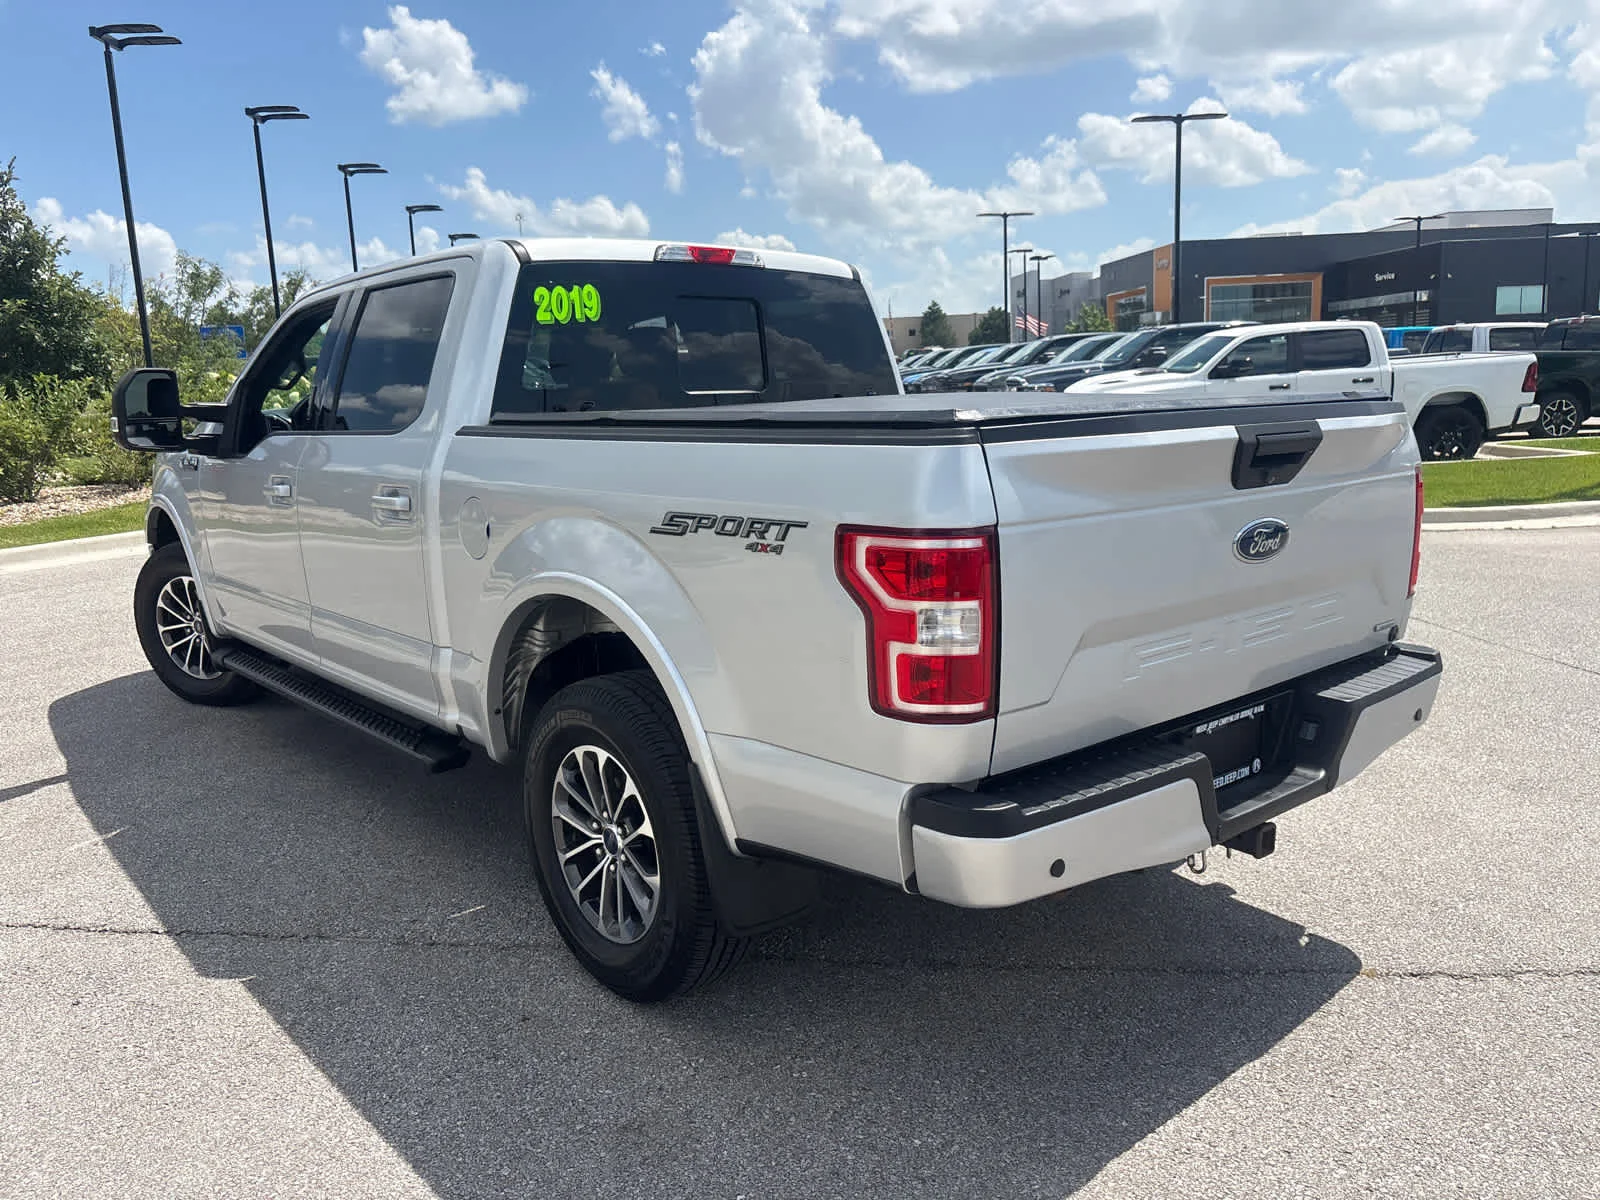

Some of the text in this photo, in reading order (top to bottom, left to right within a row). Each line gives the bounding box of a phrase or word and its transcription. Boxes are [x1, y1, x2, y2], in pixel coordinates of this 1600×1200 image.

[534, 283, 601, 325] 2019
[649, 511, 809, 541] SPORT
[1250, 528, 1281, 554] Ford
[1213, 766, 1250, 789] EEDJEEP.COM
